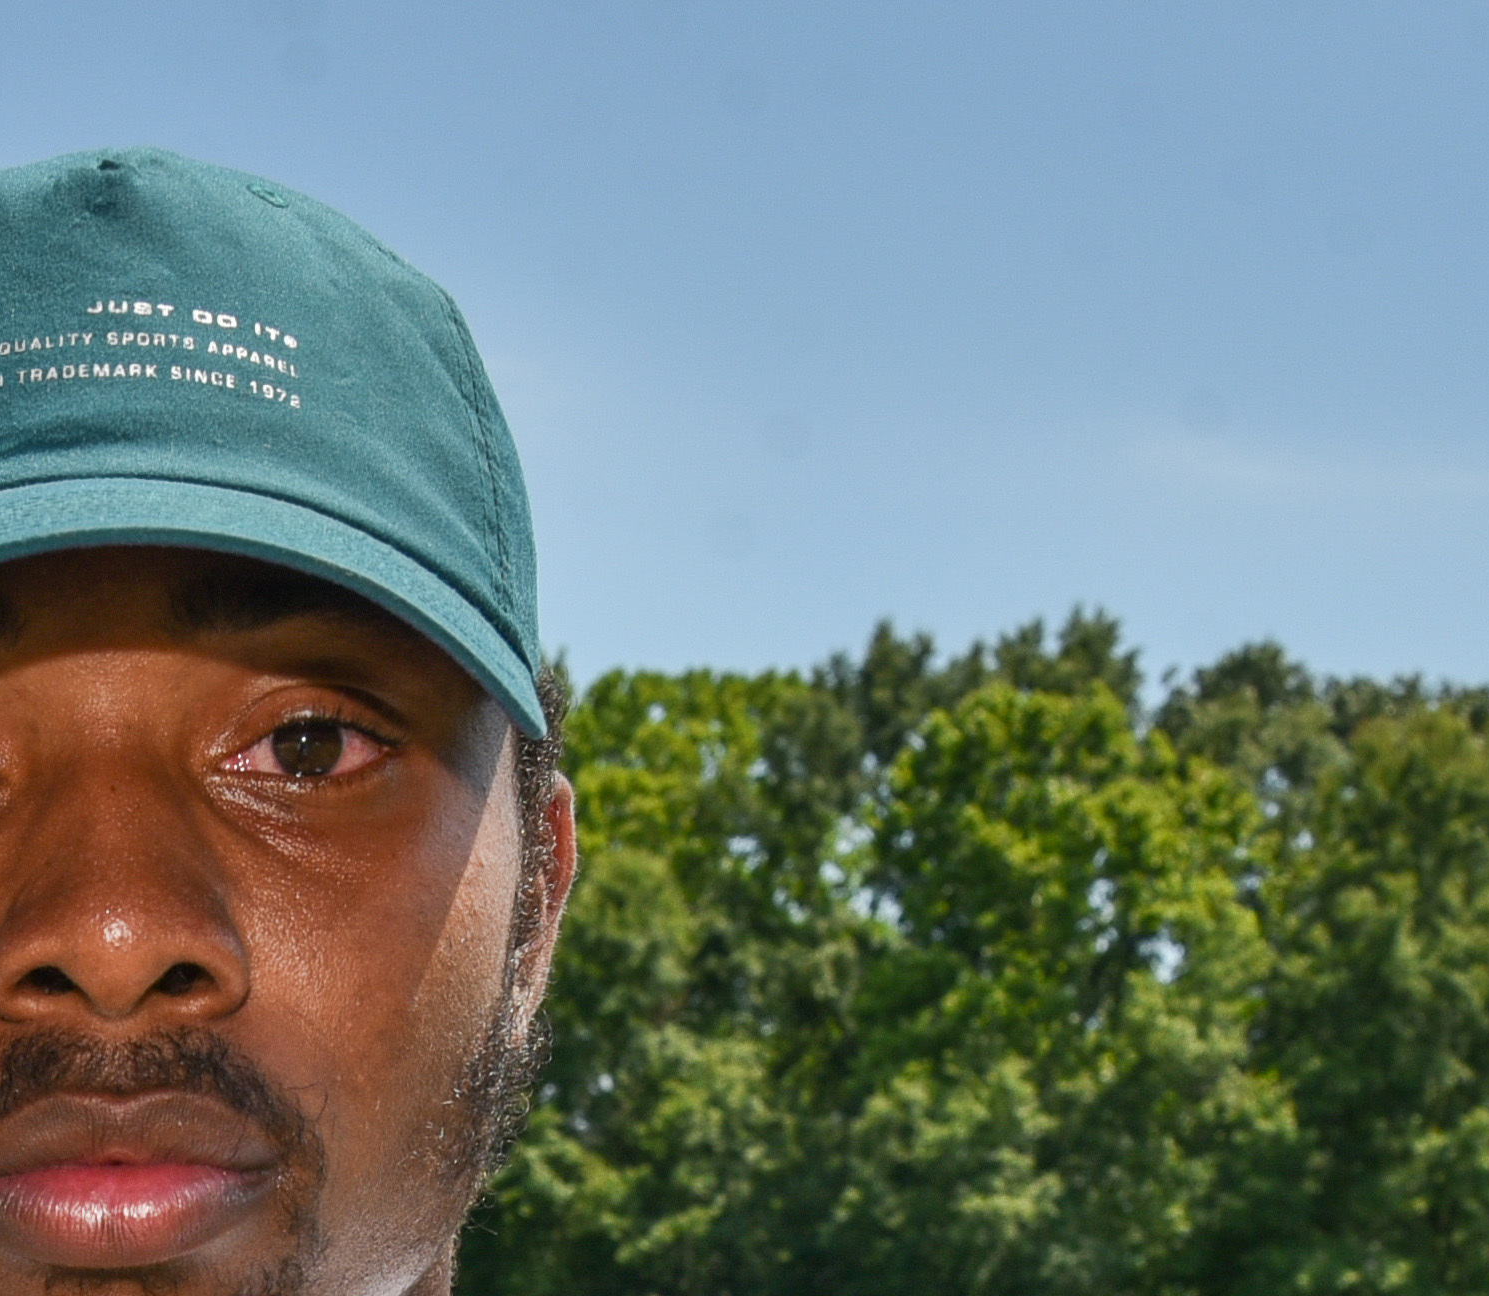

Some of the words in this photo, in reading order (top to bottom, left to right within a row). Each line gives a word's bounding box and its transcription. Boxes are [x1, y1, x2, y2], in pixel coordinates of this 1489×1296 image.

[86, 300, 175, 318] JUST
[191, 308, 239, 329] DO
[106, 331, 196, 351] SPORTS
[207, 340, 299, 378] APPAREL
[17, 363, 158, 385] TRADEMARK
[170, 365, 237, 390] SINCE
[249, 379, 302, 410] 1972
